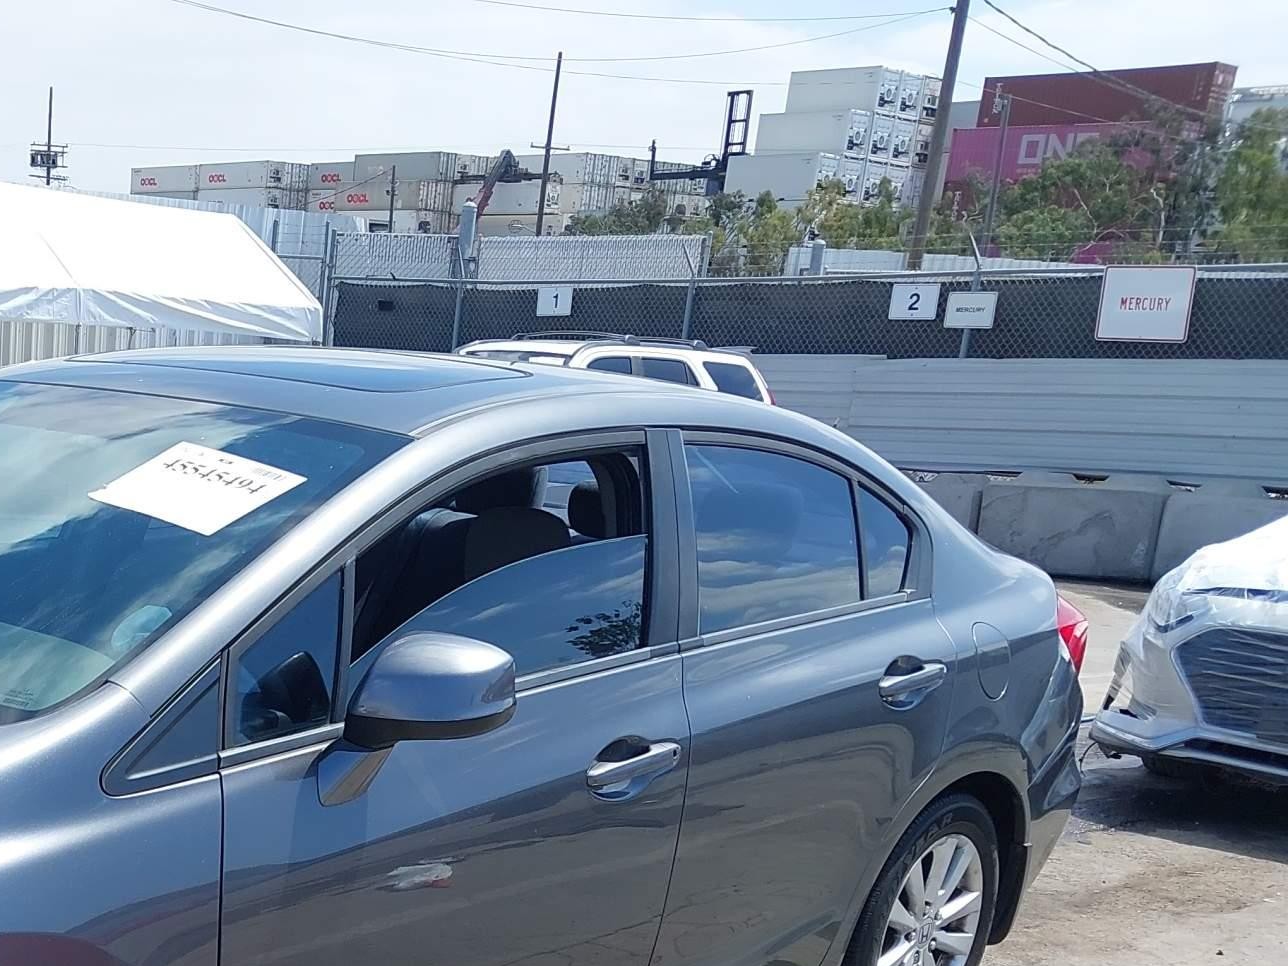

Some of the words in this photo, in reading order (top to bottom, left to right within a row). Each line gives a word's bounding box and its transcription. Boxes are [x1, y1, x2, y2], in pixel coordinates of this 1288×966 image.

[140, 177, 158, 186] OOCL
[209, 174, 227, 183] OOCL
[321, 173, 342, 183] OOCL
[347, 193, 369, 204] OOCL
[319, 201, 335, 210] OOC
[552, 293, 559, 309] 1
[907, 292, 920, 311] 2
[1119, 296, 1172, 311] MERCURY
[955, 306, 986, 314] MERCURY
